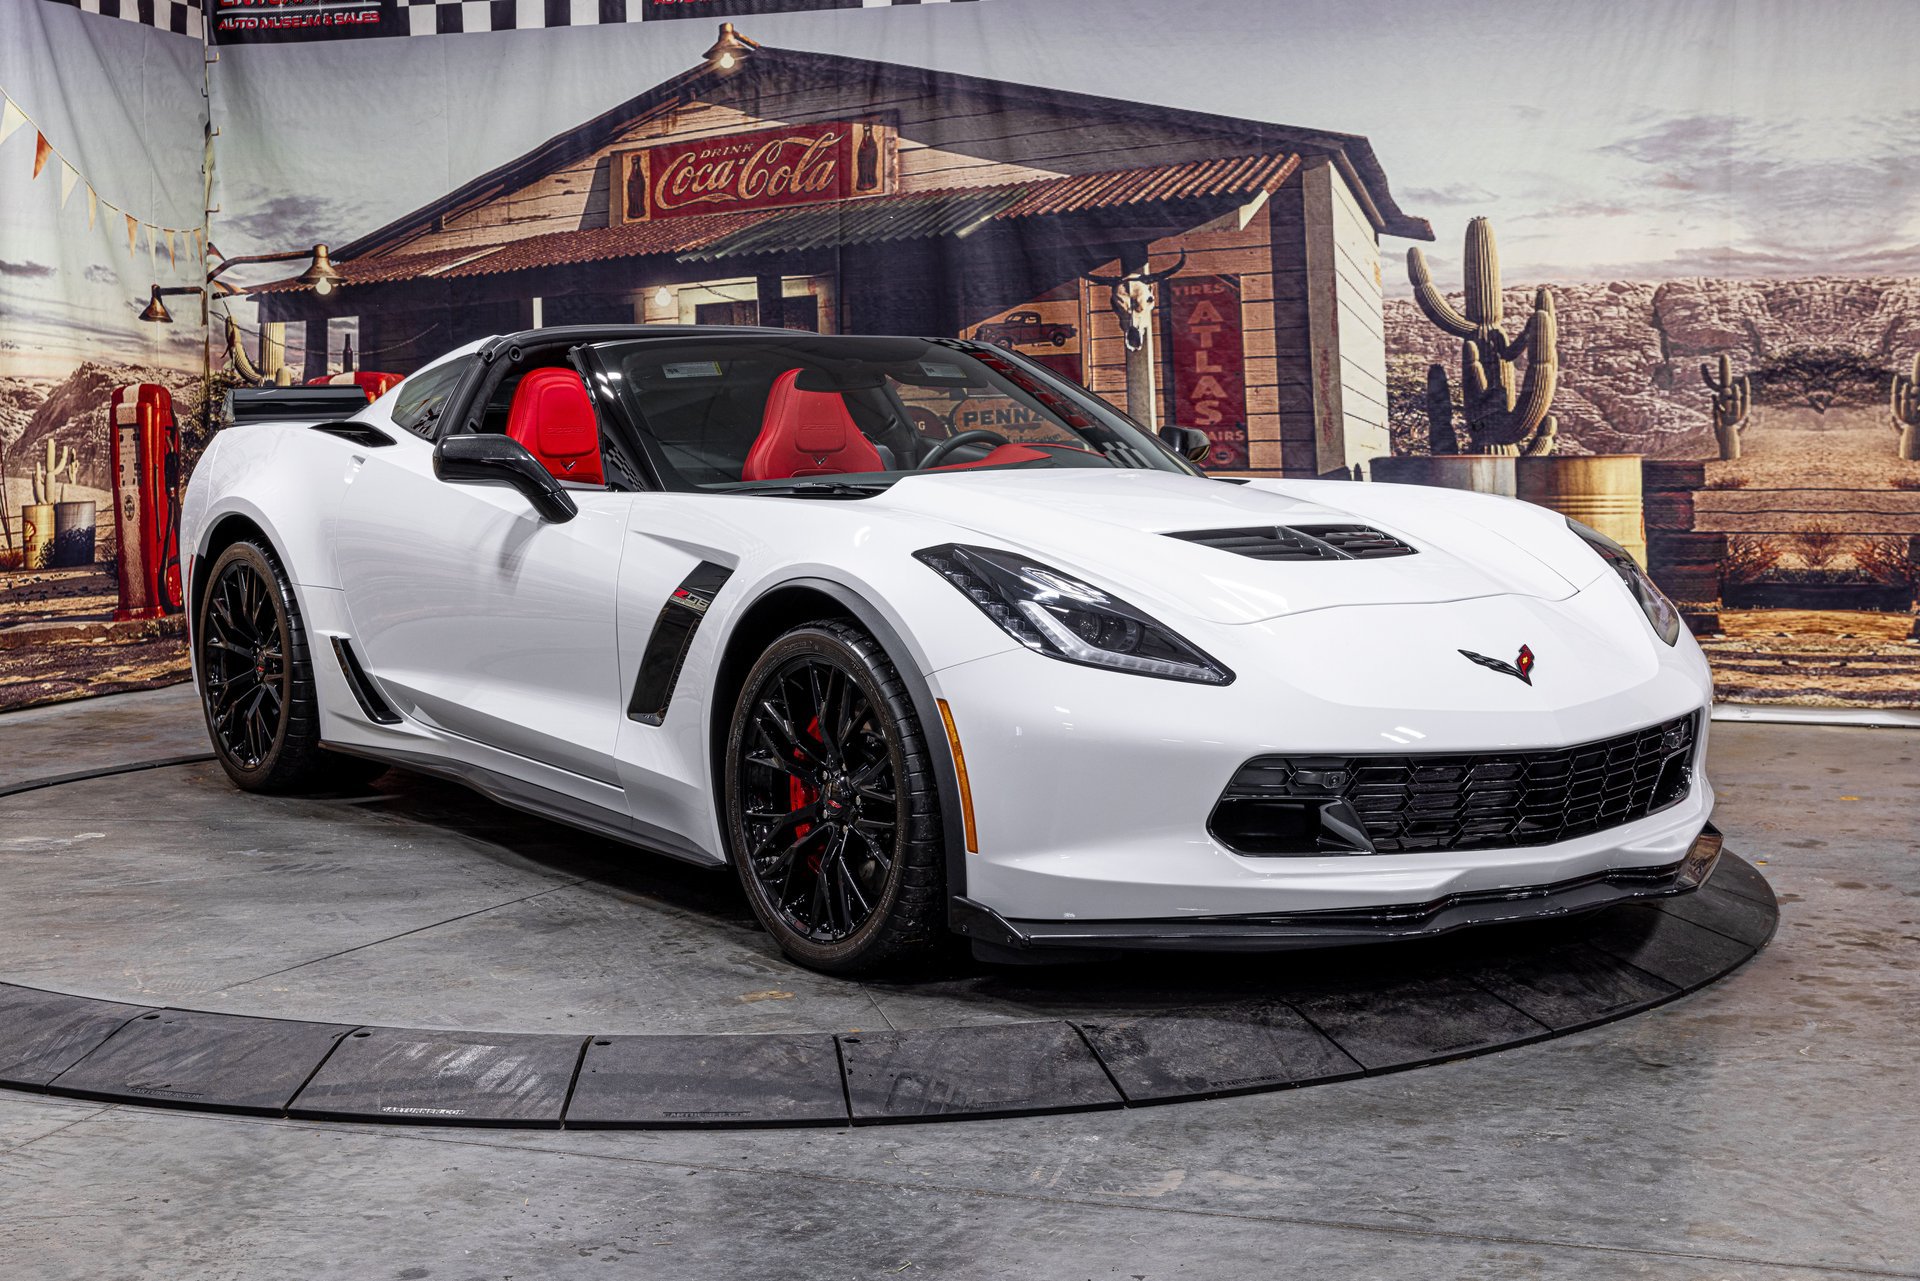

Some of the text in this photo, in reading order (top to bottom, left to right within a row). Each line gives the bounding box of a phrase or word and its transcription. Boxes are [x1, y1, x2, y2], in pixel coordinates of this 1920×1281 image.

[217, 10, 382, 30] AUTO MUSEUM & SALES
[699, 142, 754, 160] DRINK
[654, 130, 848, 210] Coca-Cola
[1172, 284, 1225, 296] TIRES
[1187, 300, 1228, 426] ATLAS
[963, 406, 1044, 428] PENNZ
[1208, 429, 1246, 442] AIRS
